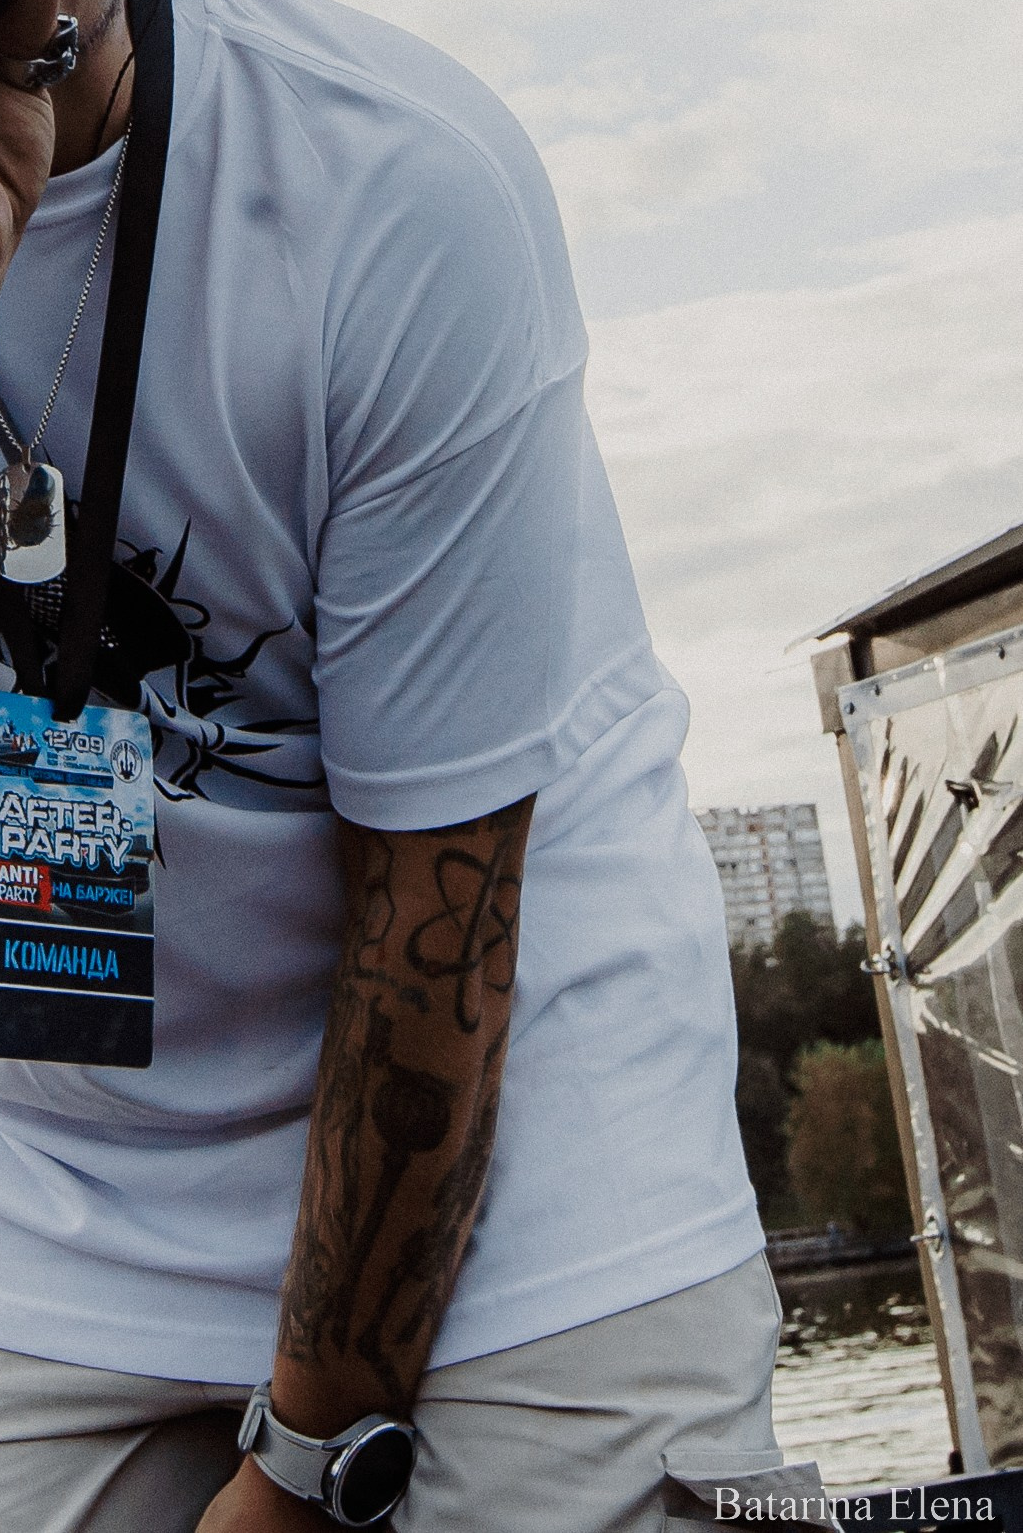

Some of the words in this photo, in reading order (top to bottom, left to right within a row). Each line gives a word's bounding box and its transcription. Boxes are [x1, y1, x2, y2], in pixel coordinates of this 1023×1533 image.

[44, 728, 104, 754] 12/09
[2, 825, 129, 867] PARTY
[52, 881, 72, 899] НА
[4, 939, 119, 981] КОМАНДА
